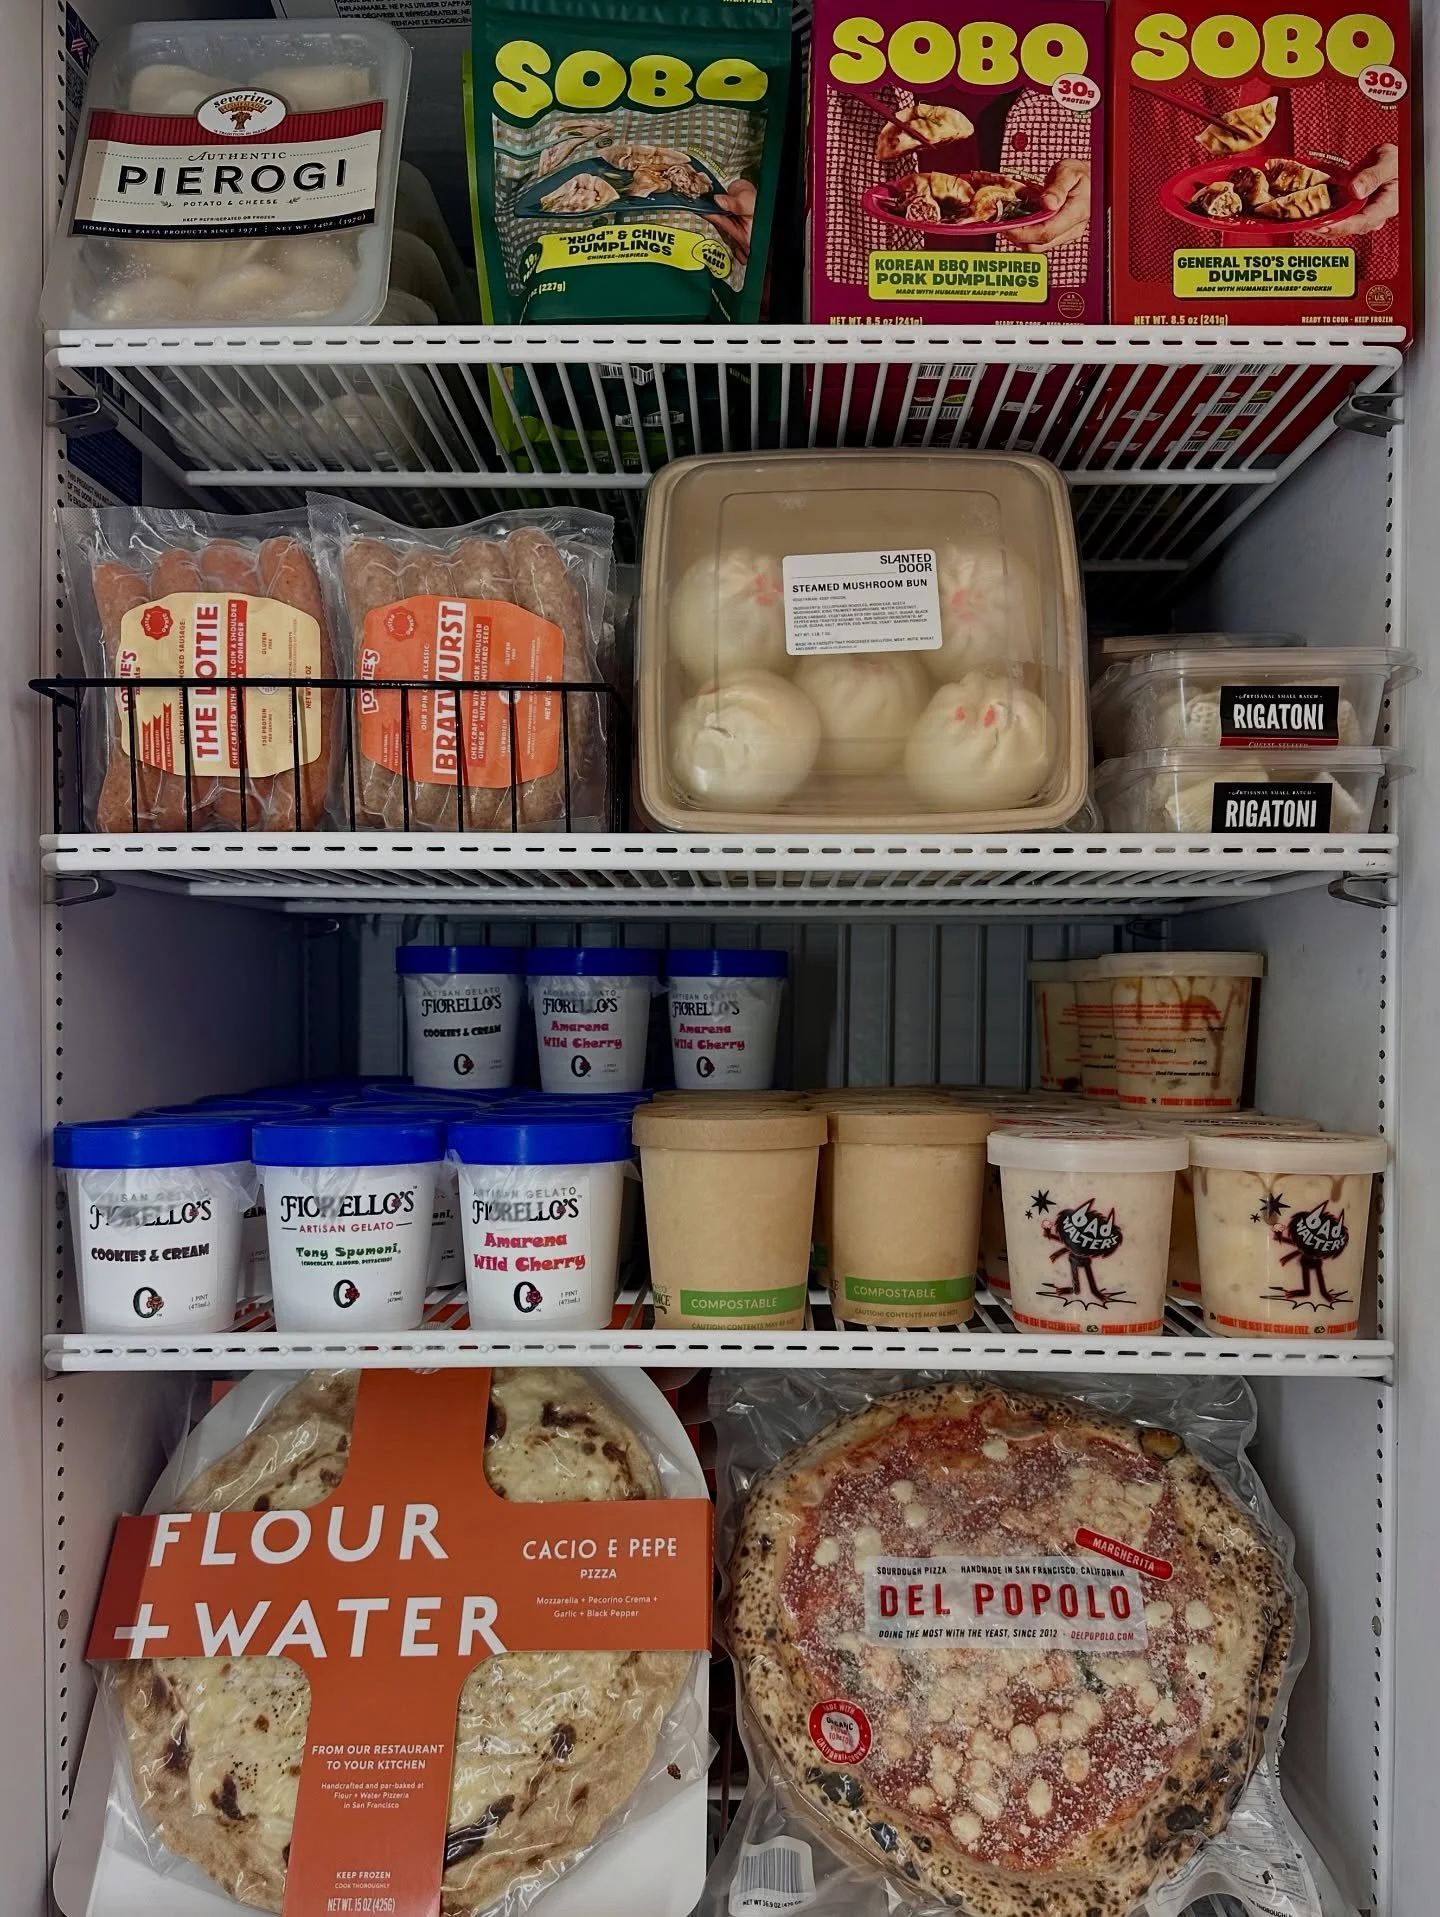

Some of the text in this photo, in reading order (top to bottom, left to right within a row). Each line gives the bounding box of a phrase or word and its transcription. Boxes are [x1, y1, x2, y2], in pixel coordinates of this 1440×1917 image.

[829, 16, 1089, 86] SOBO
[1131, 12, 1395, 81] SOBO
[493, 40, 768, 118] SOBO
[1364, 70, 1402, 90] 30g
[1058, 79, 1095, 99] 30g
[1368, 87, 1398, 97] PROTEIN
[214, 92, 273, 108] severino
[1062, 96, 1091, 105] PROTEIN
[188, 151, 287, 161] AUTHENTIC
[117, 158, 346, 195] PIEROGI
[83, 225, 132, 234] HOMEMADE
[617, 229, 675, 245] & CHIVE
[569, 240, 672, 256] DUMPLINGS
[701, 248, 726, 260] PLANT
[586, 252, 649, 261] CHINESE-INSPIRED
[703, 253, 725, 270] BASED
[1177, 256, 1349, 269] GENERAL TSO'S CHICKEN
[875, 258, 1041, 274] KOREAN BBQ INSPIRED
[876, 273, 1039, 288] PORK DUMPLINGS
[1208, 269, 1318, 283] DUMPLINGS
[1134, 315, 1199, 325] NET WT. 8.5 oz
[880, 553, 932, 565] SLANTED
[898, 563, 932, 573] DOOR
[792, 578, 927, 593] STEAMED MUSHROOM BUN
[195, 606, 219, 758] THE LOTTIE
[436, 605, 463, 770] BRATWURST
[471, 623, 483, 760] CHEF-CRAFTED SHOULDER
[1233, 703, 1324, 730] RIGATONI
[231, 714, 239, 765] CHEF-CRAFTED
[1225, 800, 1317, 828] RIGATONI
[421, 994, 502, 1017] FIORELLO'S
[423, 1024, 501, 1038] COOKIES & CREAM
[551, 1020, 609, 1032] Amarena
[679, 1023, 732, 1034] Amarena
[543, 1036, 622, 1049] Wild Cherry
[674, 1038, 745, 1051] Wild Cherry
[526, 1186, 577, 1199] GELATO
[472, 1198, 579, 1225] FIORELLO'S
[351, 1221, 394, 1232] GELATO
[1062, 1216, 1118, 1250] WALTER'S
[484, 1232, 567, 1249] Amarena
[1297, 1219, 1345, 1252] WALTER'S
[91, 1243, 210, 1262] COOKIES & CREAM
[295, 1247, 329, 1260] Tony
[474, 1254, 586, 1272] Wild Cherry
[564, 1290, 578, 1298] PINT
[853, 1285, 937, 1298] COMPOSTABLE
[691, 1297, 777, 1310] COMPOSTABLE
[149, 1504, 449, 1567] FLOUR
[523, 1537, 677, 1560] CACIO E PEPE
[1092, 1537, 1155, 1572] MARGHERITA
[580, 1568, 617, 1579] PIZZA
[876, 1565, 1125, 1577] SOURDOUGH PIZZA HANDMADE IN SAN FRANCISCO, CALIFORNIA
[536, 1596, 651, 1605] Mozzarella Pecorino Crema
[879, 1583, 1131, 1620] DEL POPOLO
[553, 1609, 640, 1619] Garlic Black Pepper
[114, 1596, 508, 1659] + WATER
[878, 1628, 1134, 1641] DOING THE MOST WITH THE YEAST, SINCE 2012 DELPOPOLO.COM
[311, 1744, 445, 1755] FROM OUR RESTAURANT
[326, 1760, 426, 1770] TO YOUR KITCHEN
[321, 1782, 364, 1790] Handcrafted
[380, 1782, 416, 1791] par-baked
[336, 1871, 391, 1879] KEEP FROZEN
[327, 1897, 396, 1913] NET WT. 15 OZ (425G)
